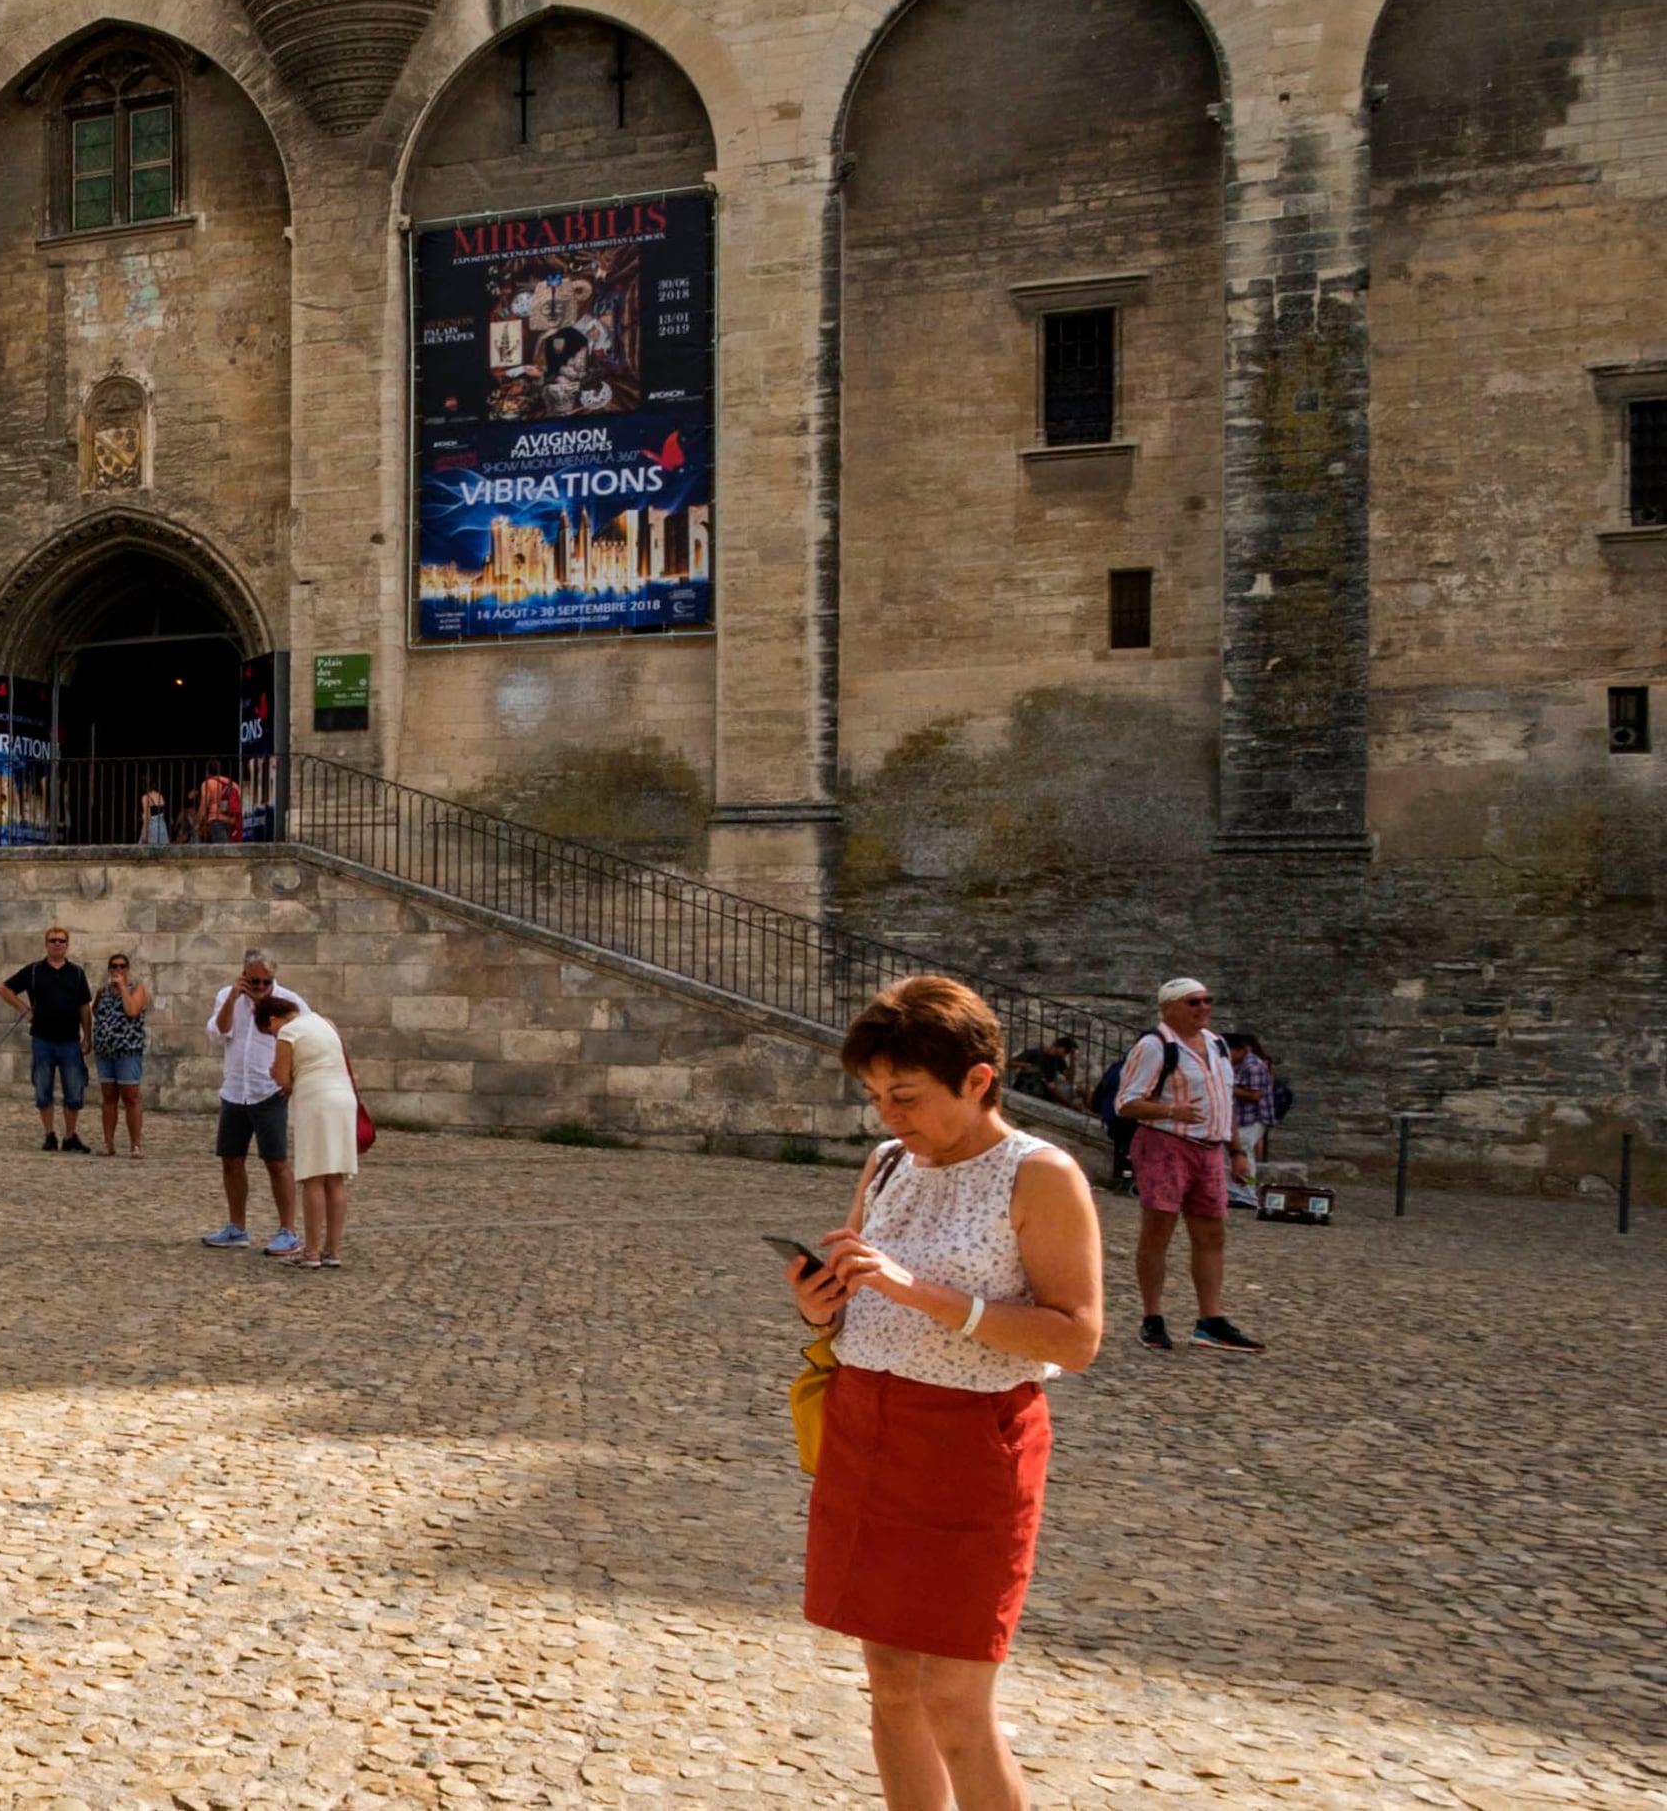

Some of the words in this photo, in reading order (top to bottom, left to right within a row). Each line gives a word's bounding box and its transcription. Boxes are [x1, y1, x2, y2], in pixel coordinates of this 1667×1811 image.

[454, 203, 666, 257] MIRABILIS
[658, 289, 689, 302] 2018
[658, 312, 689, 325] 13/01
[658, 324, 689, 336] 2019
[445, 332, 475, 342] PAPES
[515, 428, 607, 448] AVIGNON
[511, 446, 550, 459] PALAIS
[553, 444, 574, 456] DES
[577, 440, 613, 453] PAPES
[483, 460, 518, 474] SHOW
[521, 454, 603, 471] MONUMENTAL
[460, 466, 663, 505] VIBRATIONS
[477, 610, 490, 620] 14
[539, 606, 555, 617] 30
[557, 602, 627, 616] SEPTEMBRE
[630, 599, 661, 611] 2018
[317, 658, 343, 667] Palais
[317, 668, 331, 676] des
[317, 678, 342, 688] Papes
